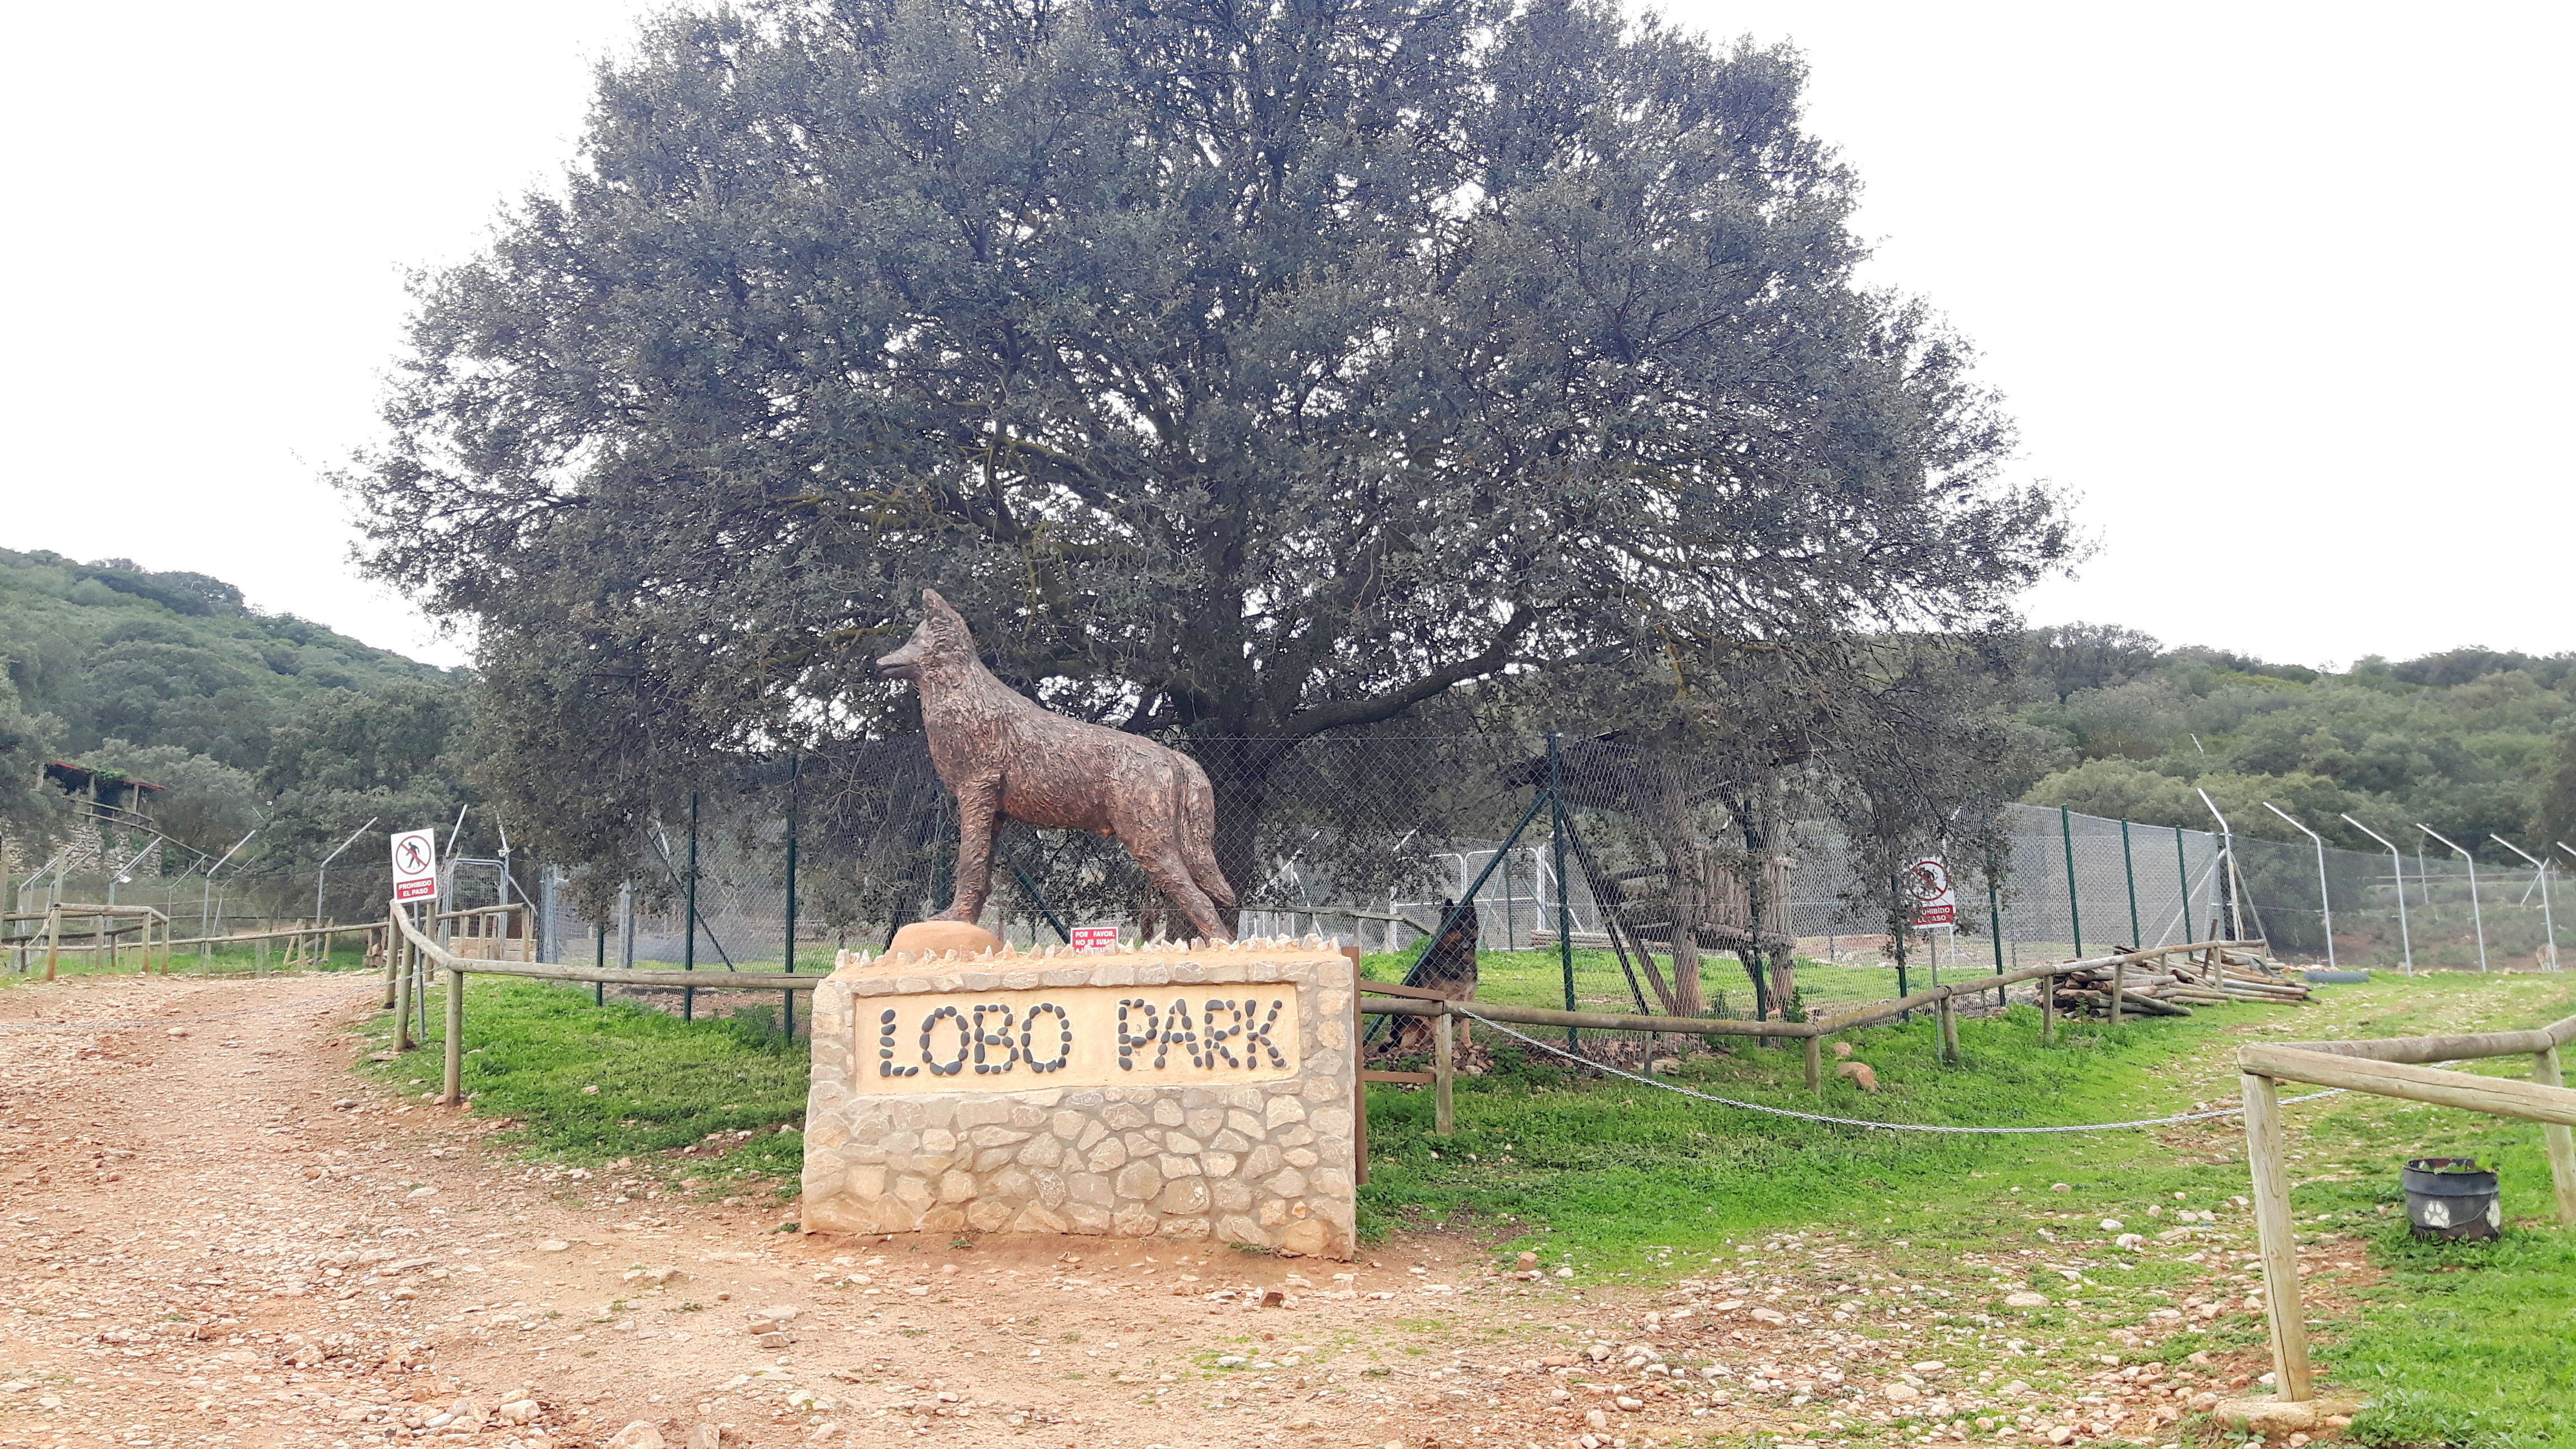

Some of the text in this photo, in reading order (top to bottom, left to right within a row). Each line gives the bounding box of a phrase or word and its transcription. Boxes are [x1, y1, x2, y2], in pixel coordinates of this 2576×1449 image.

[399, 880, 432, 890] PROHIBIDO
[1918, 907, 1950, 916] OHIBIDO
[879, 999, 1285, 1077] LOBO PARK
